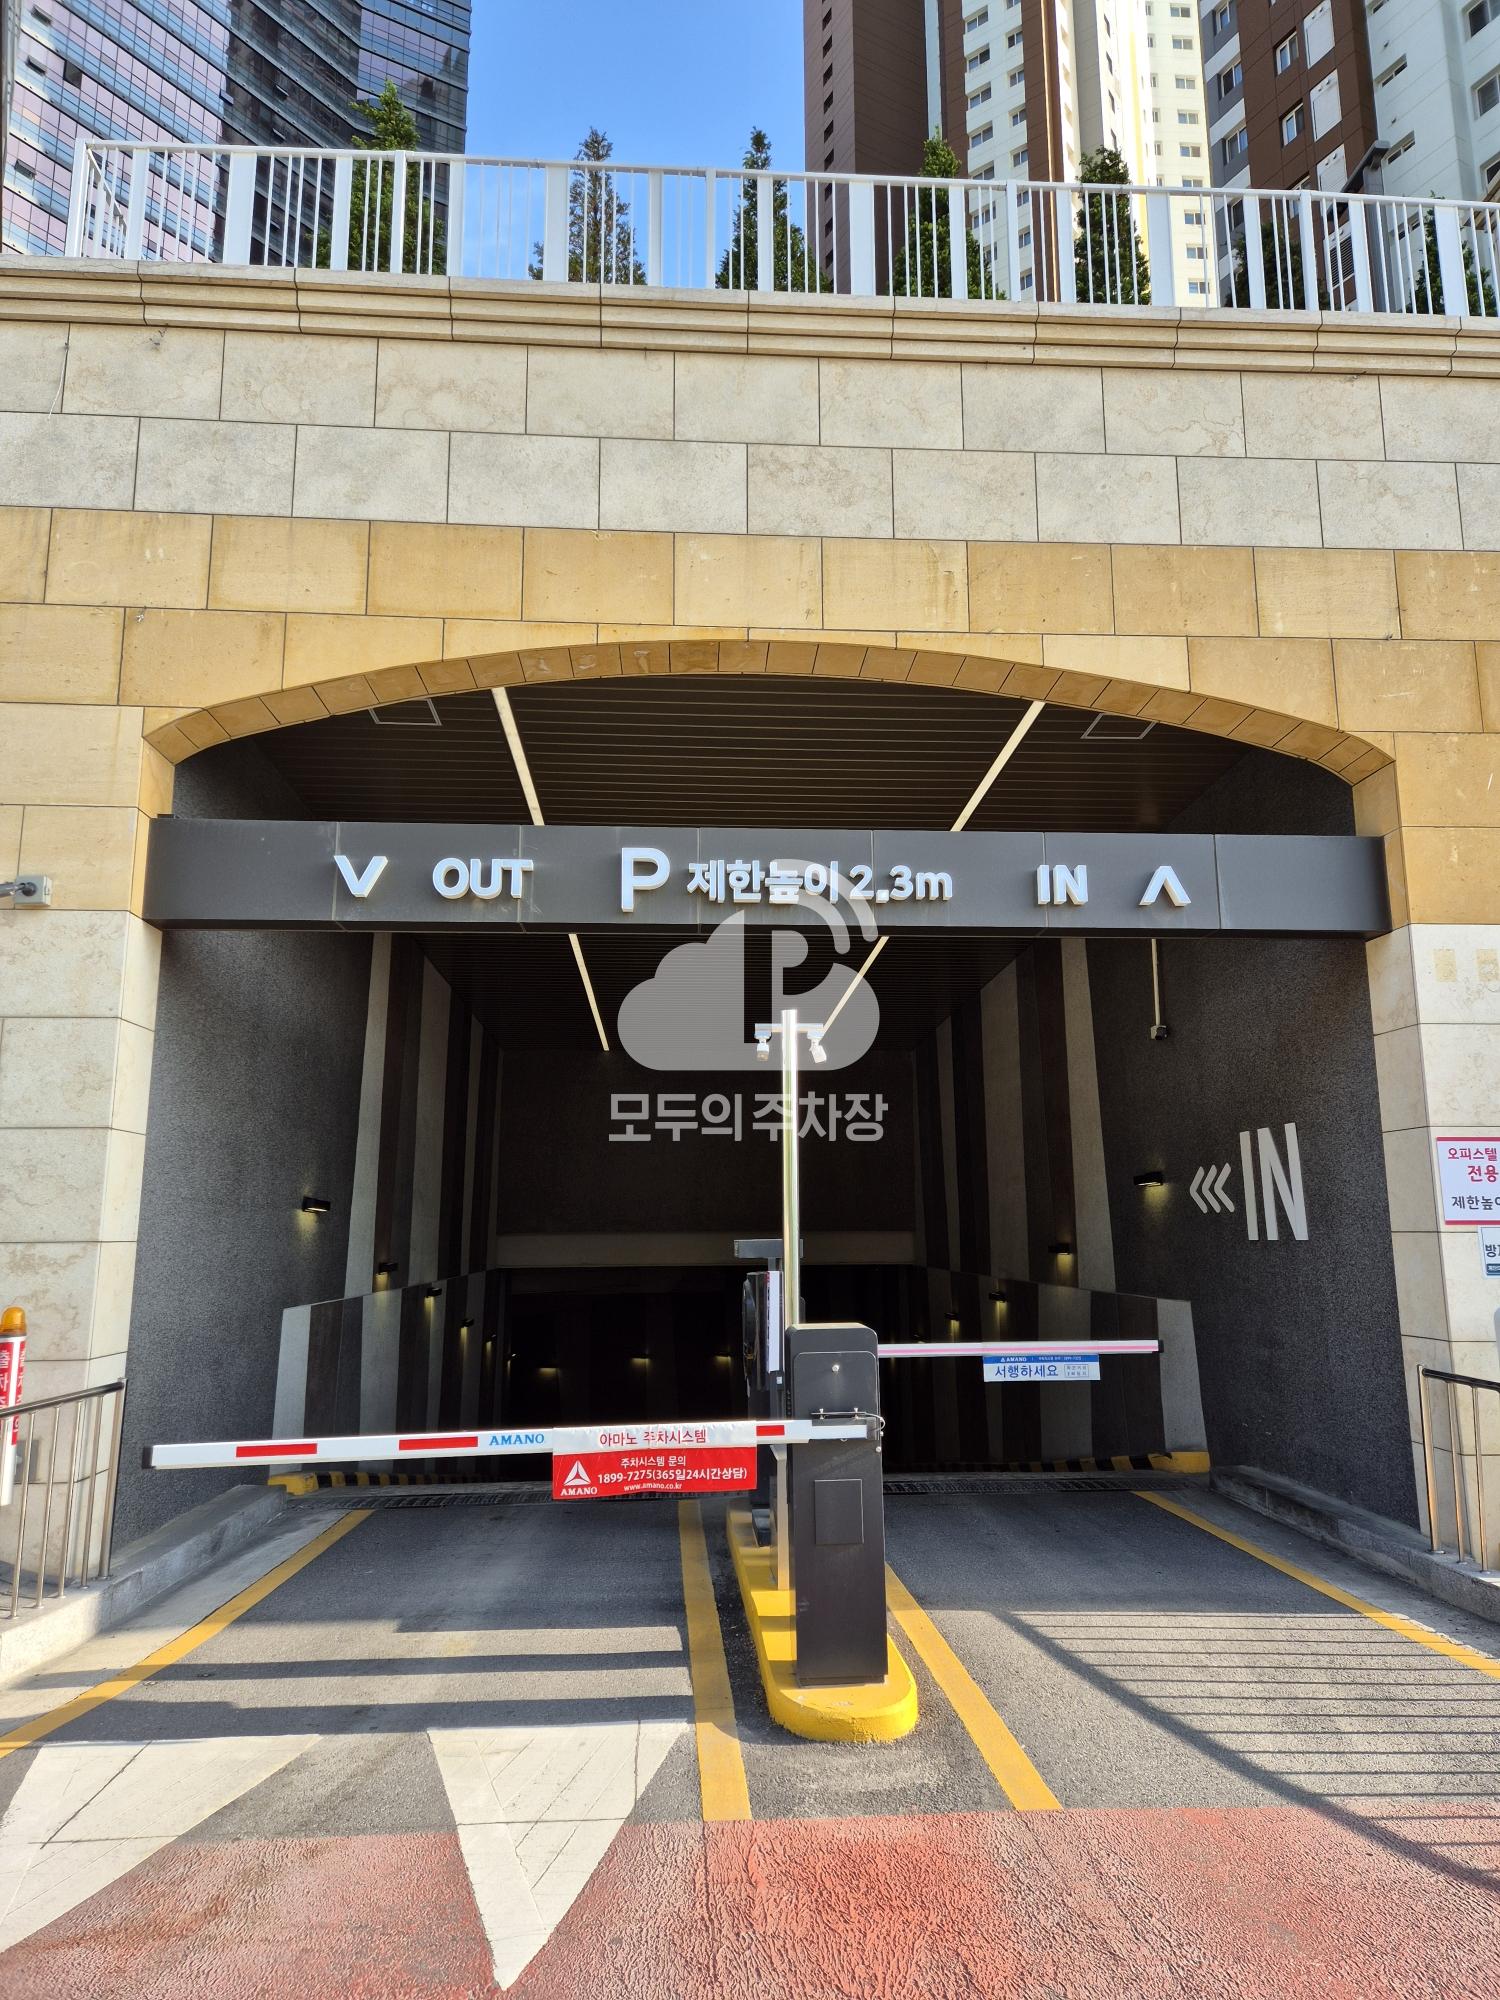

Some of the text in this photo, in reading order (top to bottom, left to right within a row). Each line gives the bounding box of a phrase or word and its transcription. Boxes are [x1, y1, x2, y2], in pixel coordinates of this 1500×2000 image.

[432, 857, 535, 900] OUT
[621, 847, 671, 913] P
[687, 858, 954, 905] 제한높이 2.3m
[1036, 864, 1089, 905] IN
[1447, 1147, 1498, 1161] 오피스텔
[1239, 1122, 1309, 1241] IN
[1467, 1165, 1499, 1183] 전용
[995, 1364, 1059, 1379] 서행하세요
[489, 1433, 545, 1446] AMANO
[600, 1428, 706, 1447] 아마노 주차시스템
[620, 1455, 686, 1469] 주차시스템 문의
[597, 1466, 748, 1485] 1899-7275(365일24시간상담)
[560, 1486, 598, 1496] AMANO
[623, 1481, 683, 1492] www.amano.co.kr
